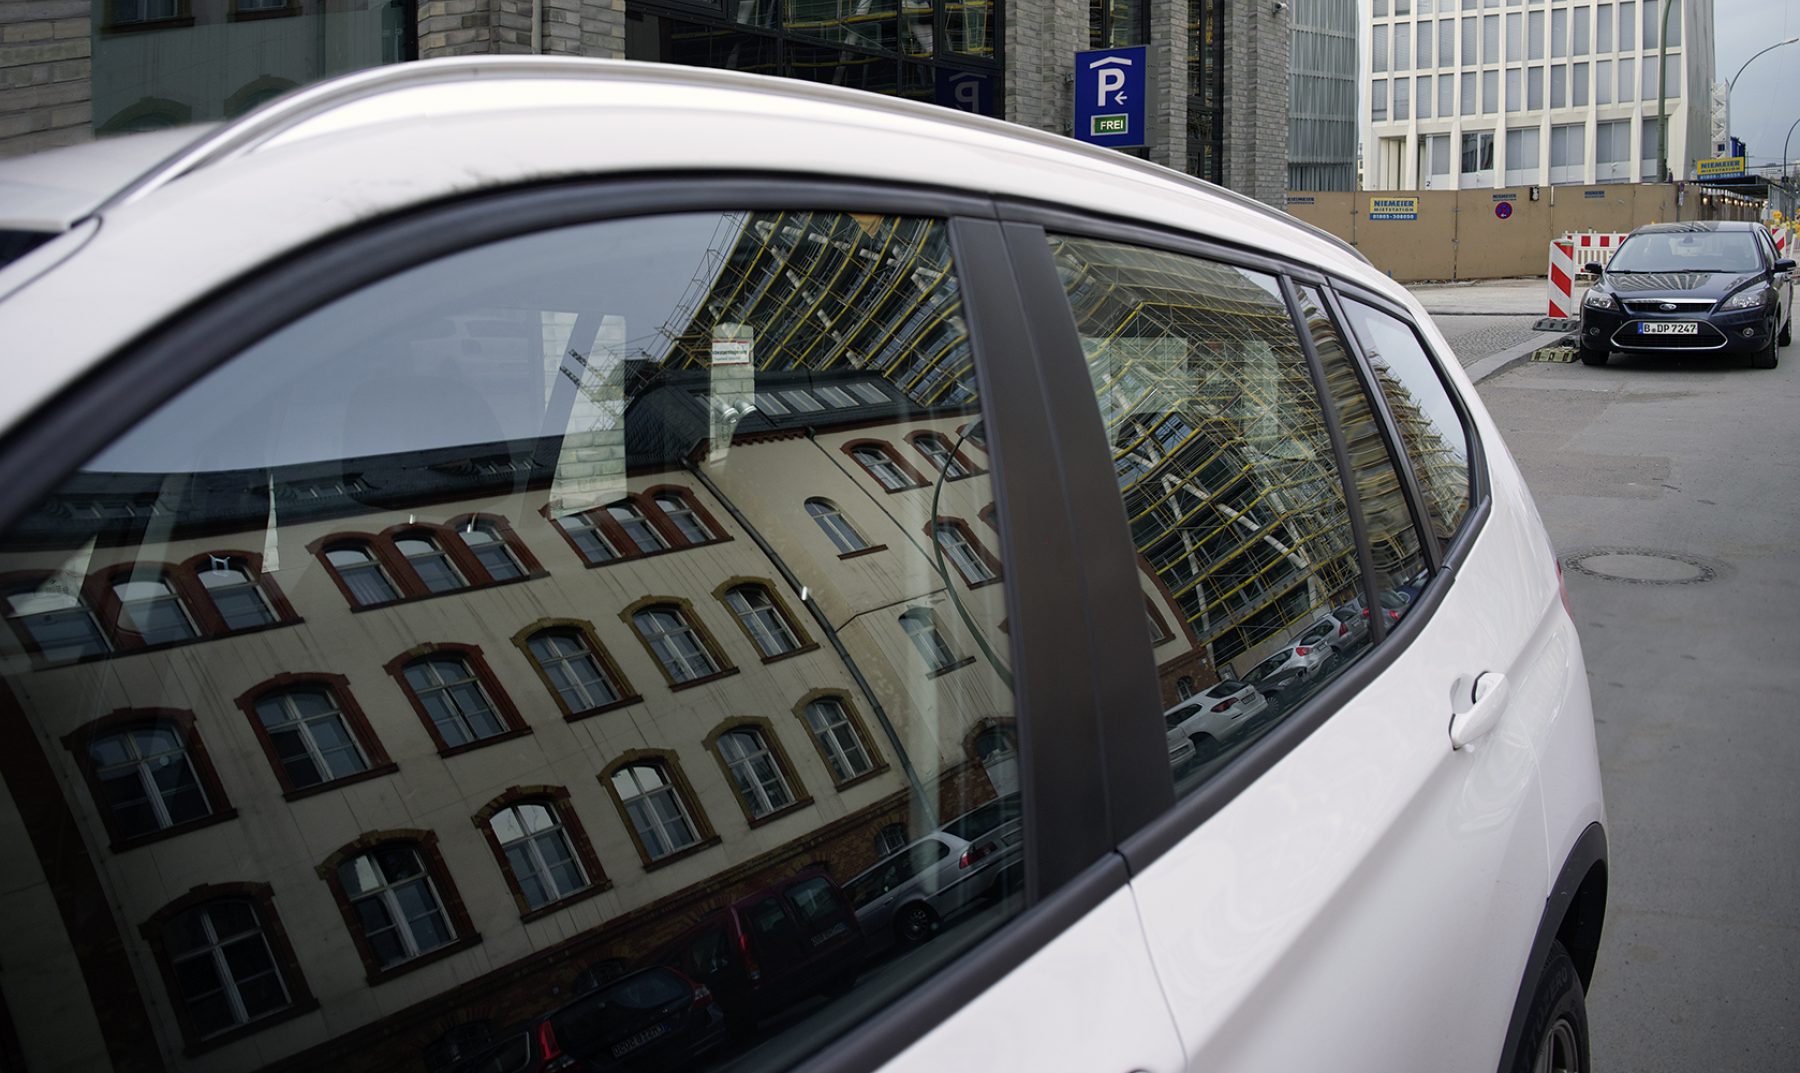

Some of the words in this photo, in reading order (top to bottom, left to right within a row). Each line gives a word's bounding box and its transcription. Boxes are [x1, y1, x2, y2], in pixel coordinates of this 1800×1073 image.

[1097, 68, 1125, 107] P
[1100, 119, 1124, 131] FREI
[1671, 324, 1696, 333] 7247
